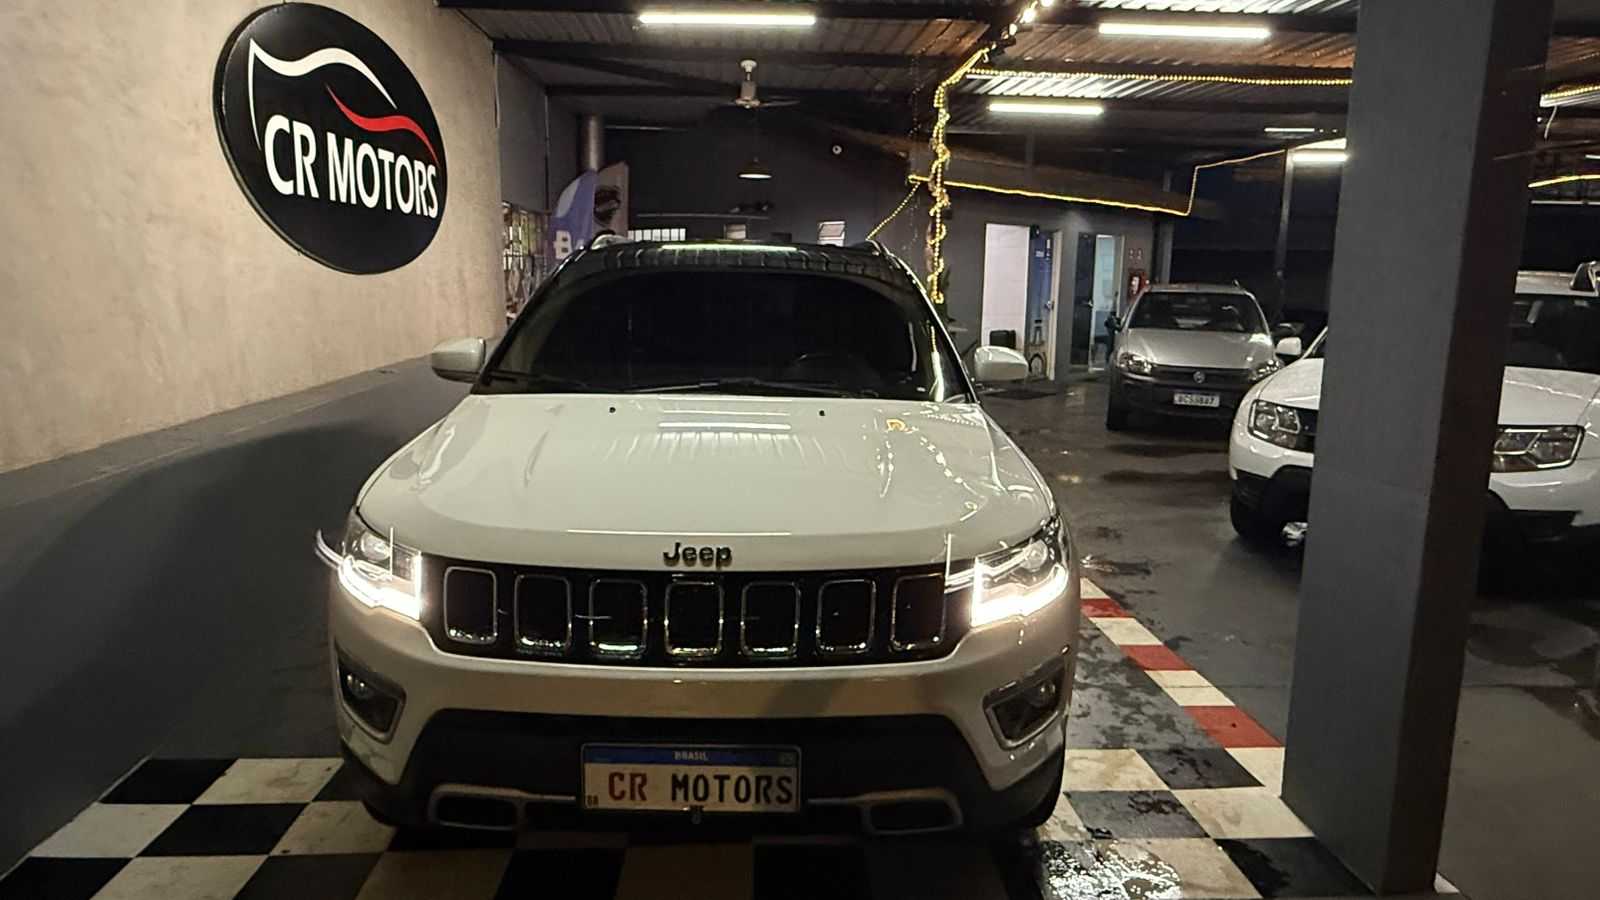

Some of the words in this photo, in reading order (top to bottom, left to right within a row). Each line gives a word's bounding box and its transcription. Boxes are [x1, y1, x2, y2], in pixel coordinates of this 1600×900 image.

[264, 114, 319, 198] CR
[326, 131, 439, 219] MOTORS
[663, 541, 733, 570] Jeep
[674, 751, 709, 761] BRASIL
[608, 772, 648, 801] CR
[671, 773, 794, 804] MOTORS
